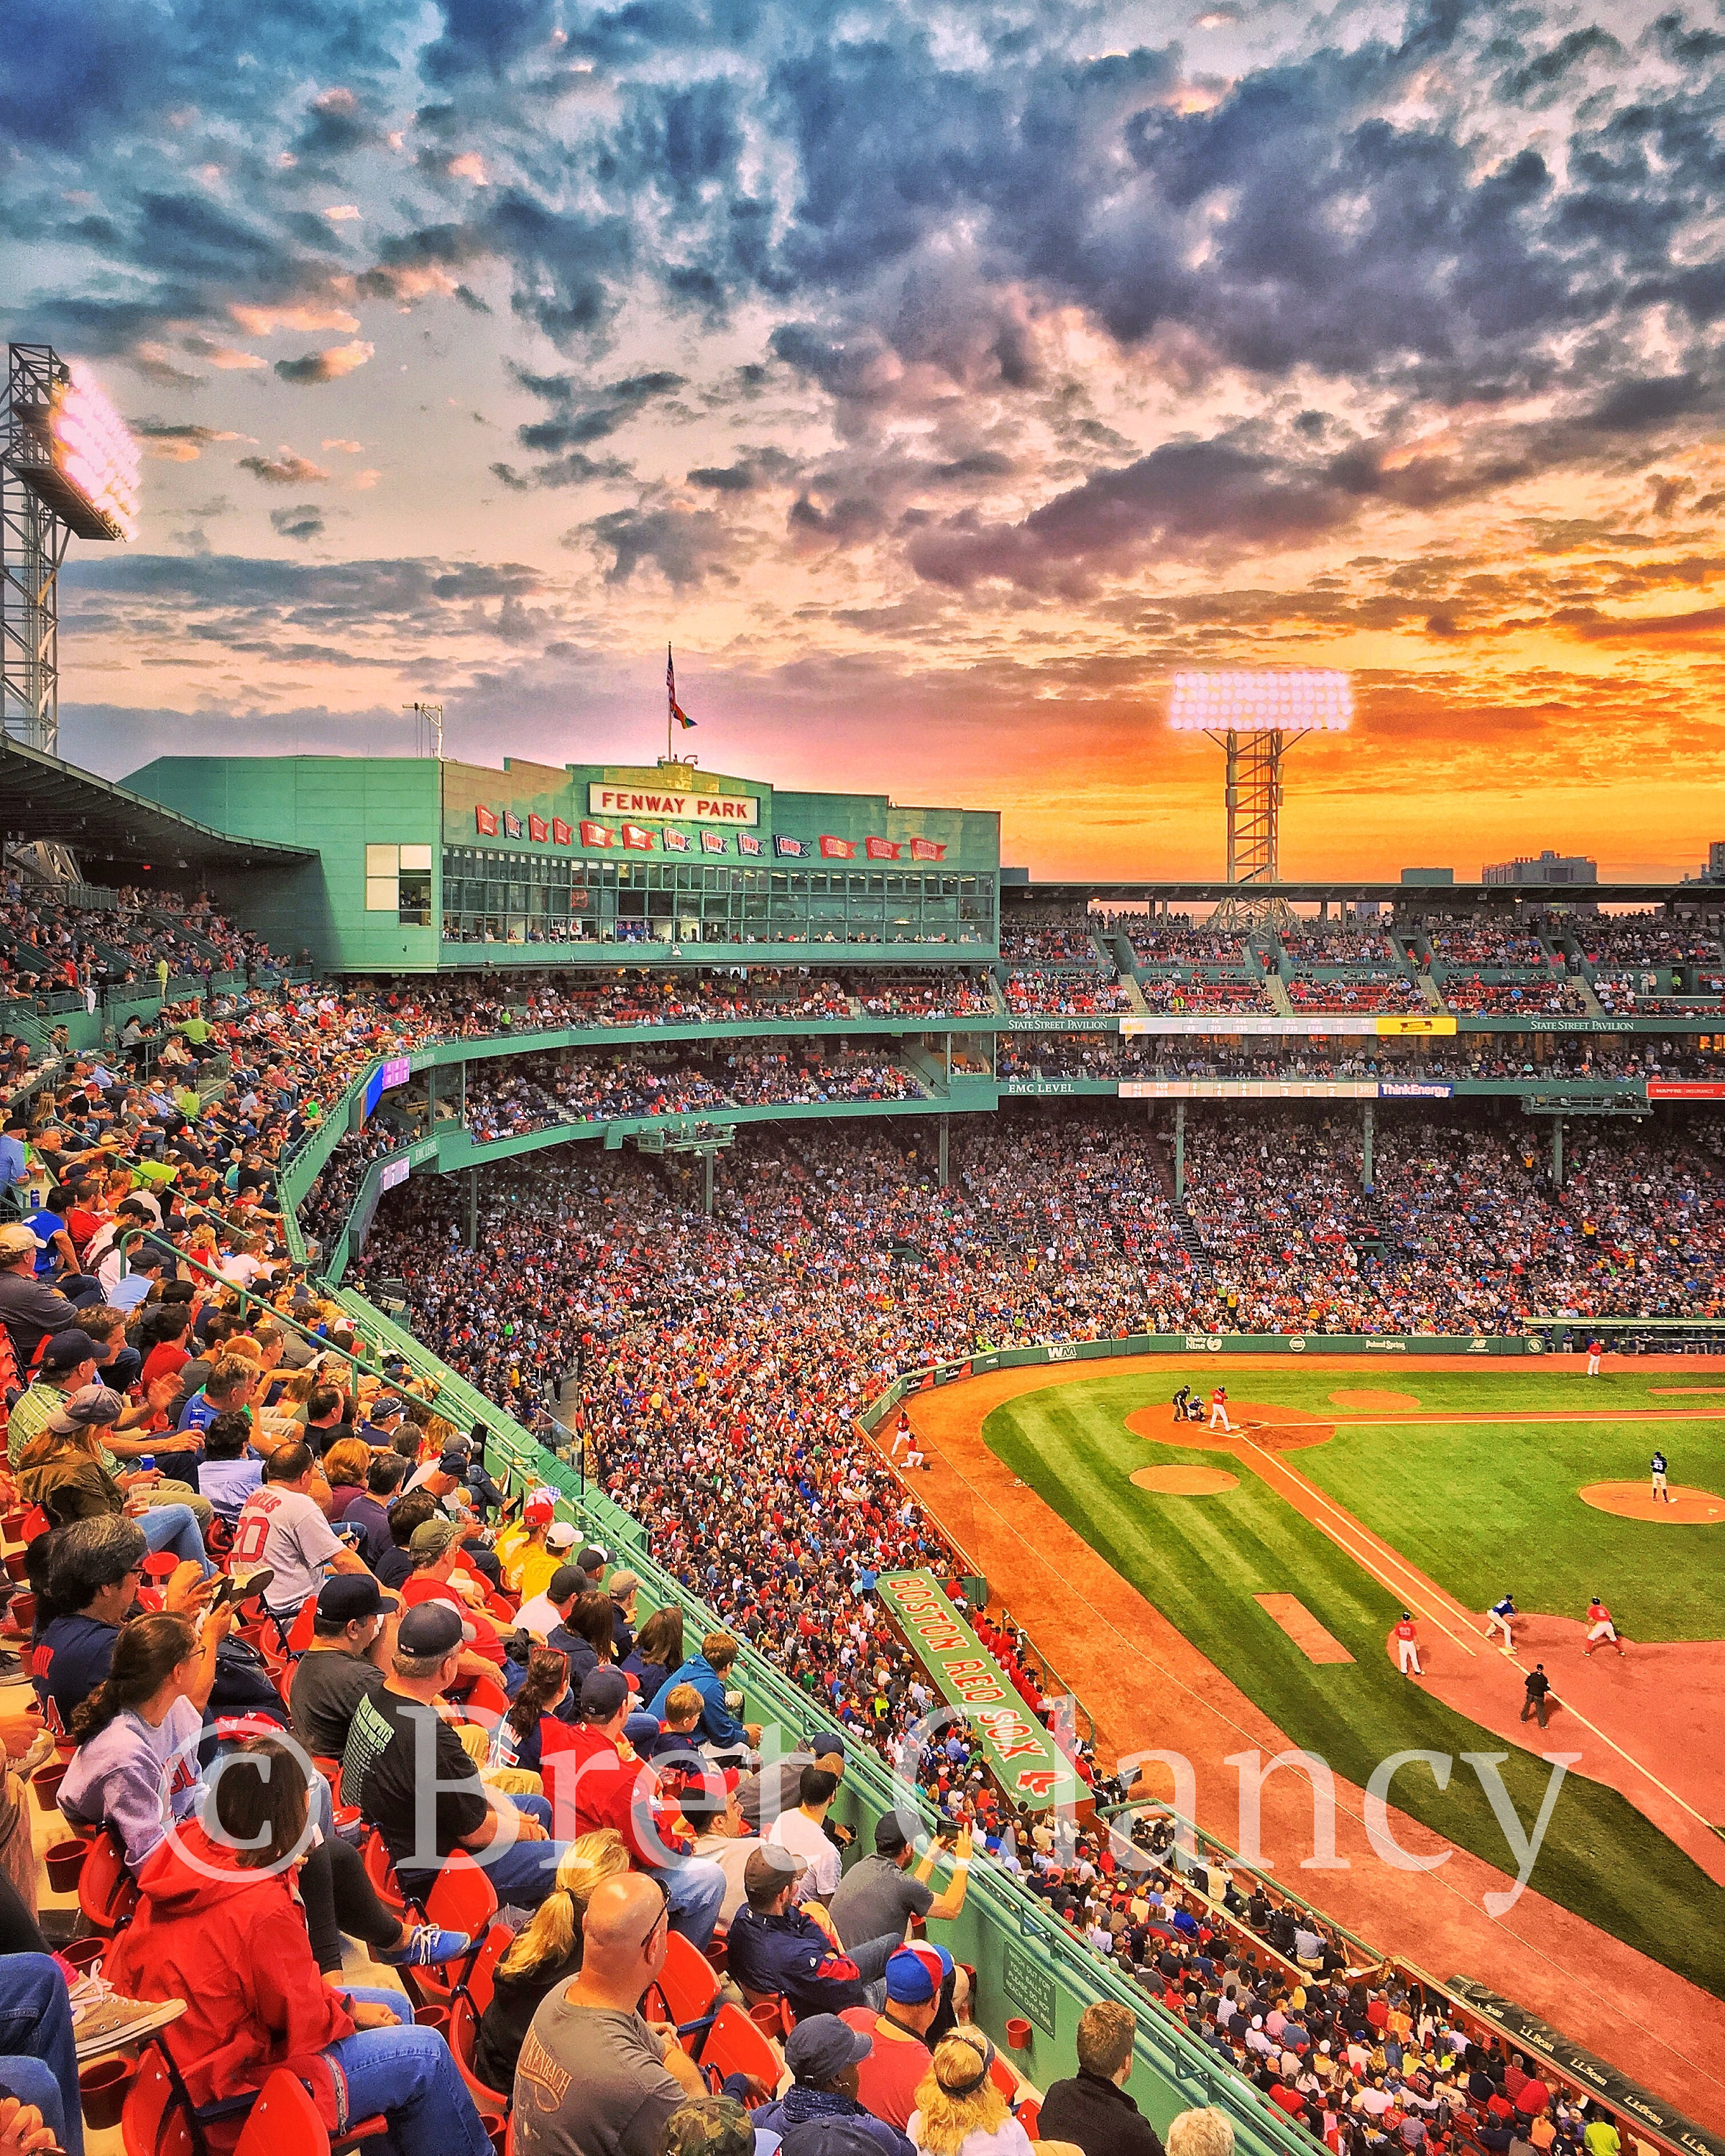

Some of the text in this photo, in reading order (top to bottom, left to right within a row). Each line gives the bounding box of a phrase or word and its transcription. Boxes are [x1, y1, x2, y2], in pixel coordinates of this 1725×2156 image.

[602, 791, 748, 819] FENWAY PARK
[1008, 1019, 1108, 1030] STATE STREET PAVILION
[1531, 1021, 1634, 1031] STATE STREET PAVILION
[1008, 1083, 1075, 1094] EMC LEVEL
[1282, 1087, 1289, 1096] 3
[1306, 1087, 1310, 1096] 1
[1329, 1087, 1335, 1096] 2
[1358, 1085, 1375, 1094] 3RD
[1381, 1083, 1451, 1097] ThinkEnergy
[1365, 1340, 1406, 1351] Poland Spring
[229, 1516, 271, 1563] 20
[886, 1576, 970, 1653] BOSTON
[942, 1658, 1007, 1703] RED
[975, 1708, 1049, 1763] SOX
[1025, 1975, 1042, 1996] BALLS
[1026, 1964, 1038, 1980] OUT
[1038, 1976, 1052, 1993] FOR
[1006, 1978, 1024, 2000] REACH
[1024, 1996, 1040, 2016] OVER
[1008, 1969, 1051, 2013] PLEASE DO NOT
